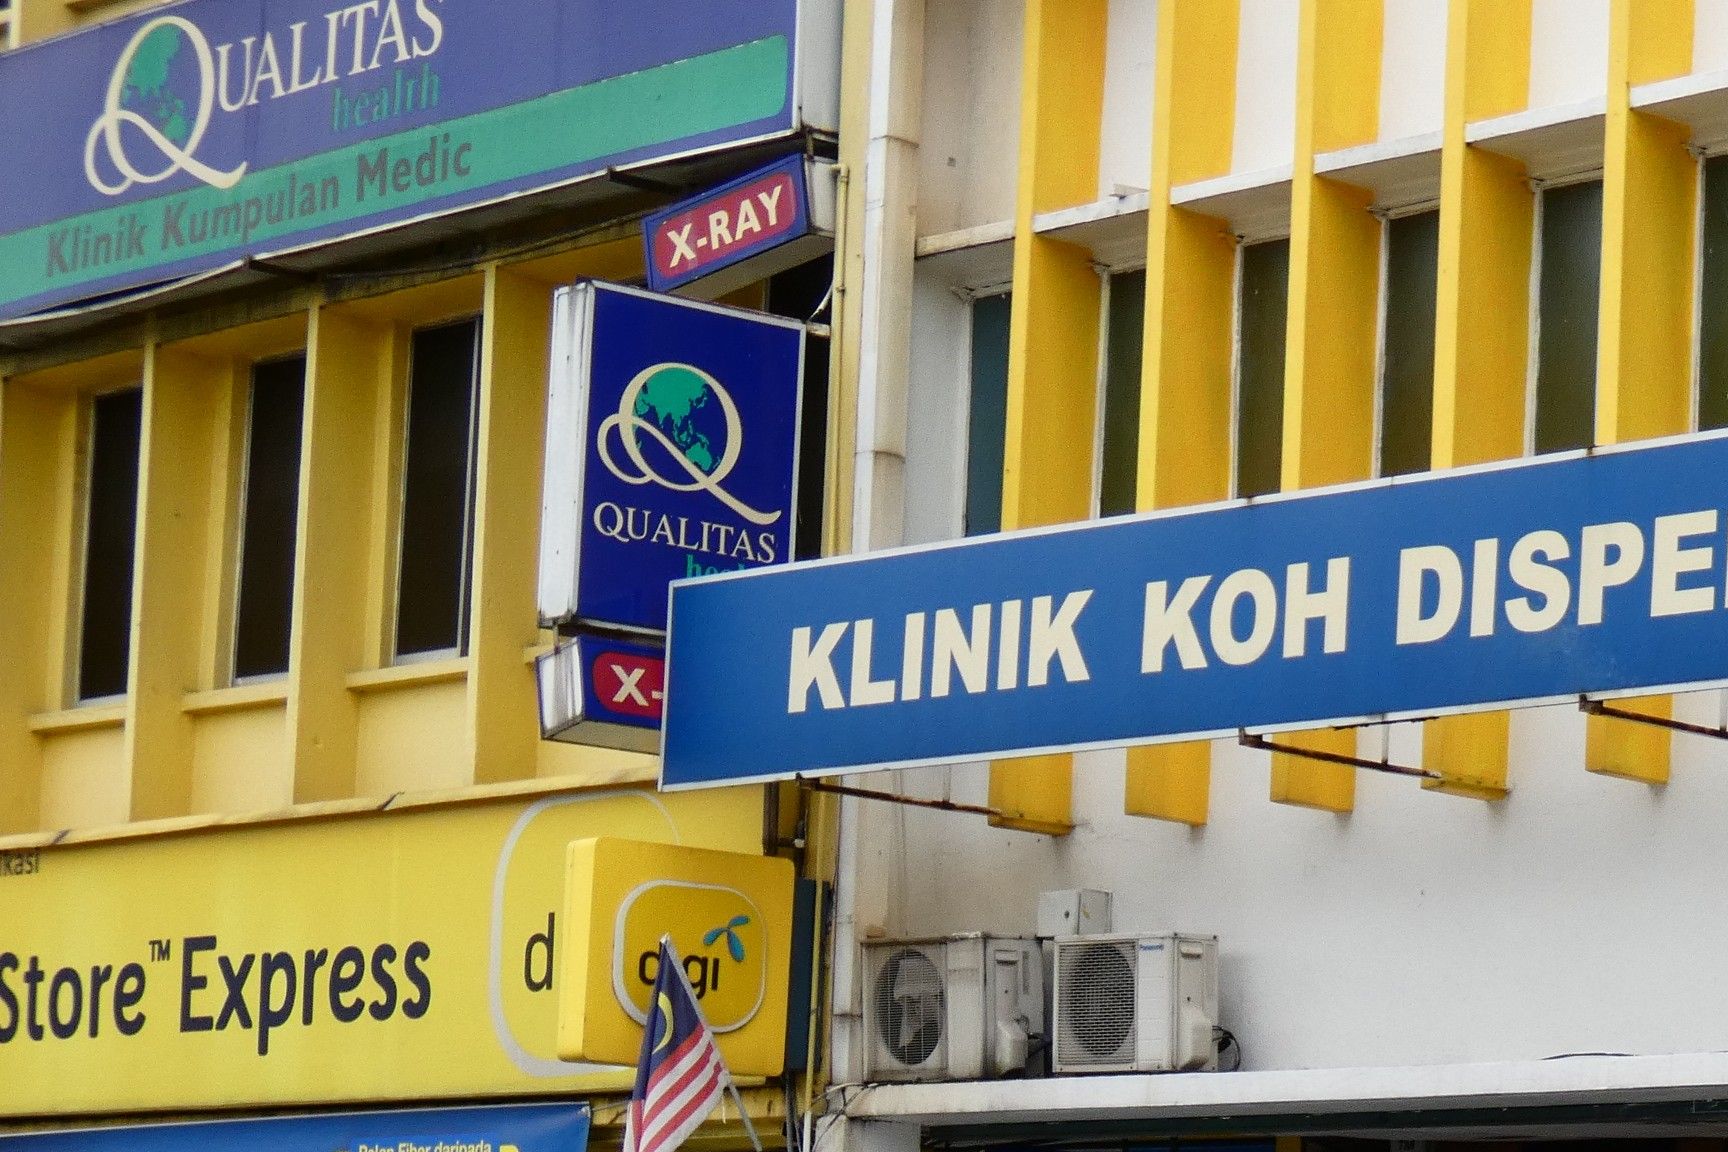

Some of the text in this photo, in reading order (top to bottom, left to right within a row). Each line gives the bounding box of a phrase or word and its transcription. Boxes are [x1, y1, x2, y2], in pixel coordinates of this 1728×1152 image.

[332, 65, 440, 131] health
[46, 136, 473, 278] Klinik Kumpulan Medic
[667, 186, 784, 268] X-RAY
[593, 502, 775, 564] QUALITAS
[788, 589, 1093, 713] KLINIK
[1141, 556, 1350, 674] KOH
[0, 951, 146, 1044] Store
[180, 935, 432, 1056] Express
[638, 934, 720, 1000] dgi
